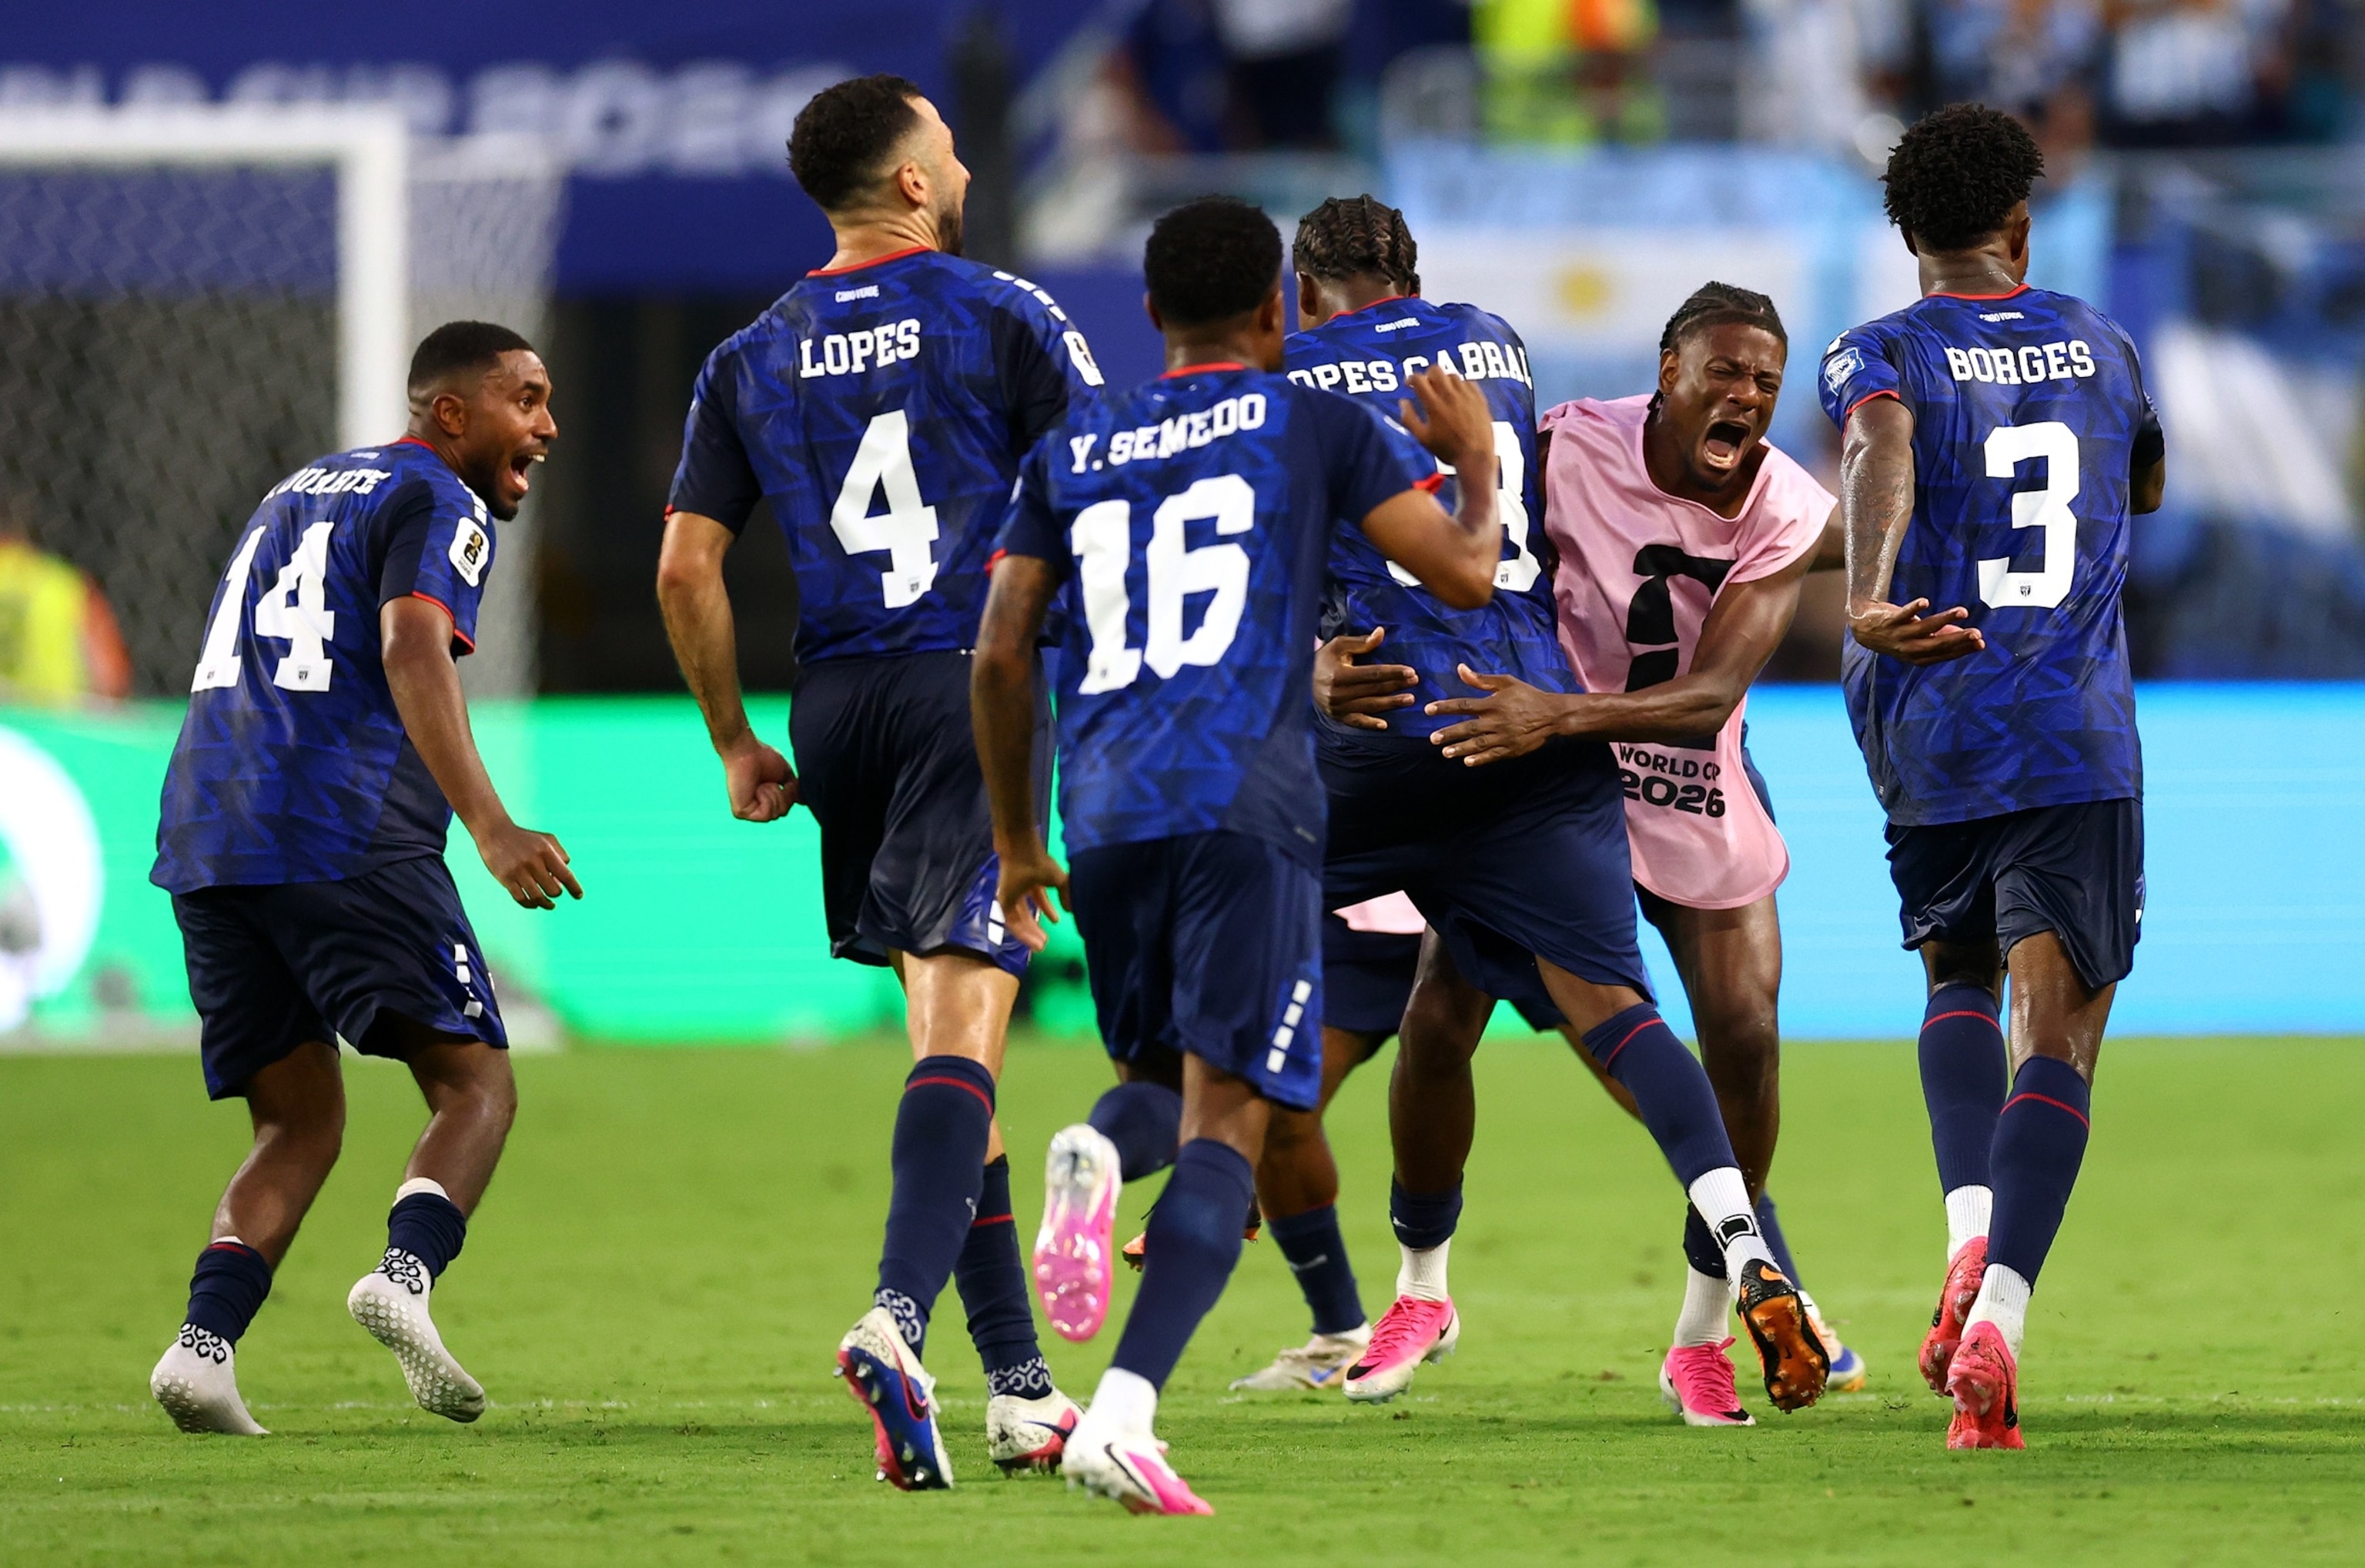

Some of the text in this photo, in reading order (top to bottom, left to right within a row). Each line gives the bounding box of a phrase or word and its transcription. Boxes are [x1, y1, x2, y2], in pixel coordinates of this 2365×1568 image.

[800, 318, 921, 379] LOPES
[1286, 359, 1399, 394] OPES
[1943, 339, 2096, 385] BORGES
[1069, 393, 1266, 474] Y. SEMEDO
[829, 409, 940, 609] 4
[1386, 420, 1542, 593] 3
[1977, 421, 2080, 610] 3
[190, 521, 336, 694] 14
[1070, 473, 1256, 696] 16
[1618, 742, 1699, 777] WORLD
[1619, 767, 1726, 818] 2026
